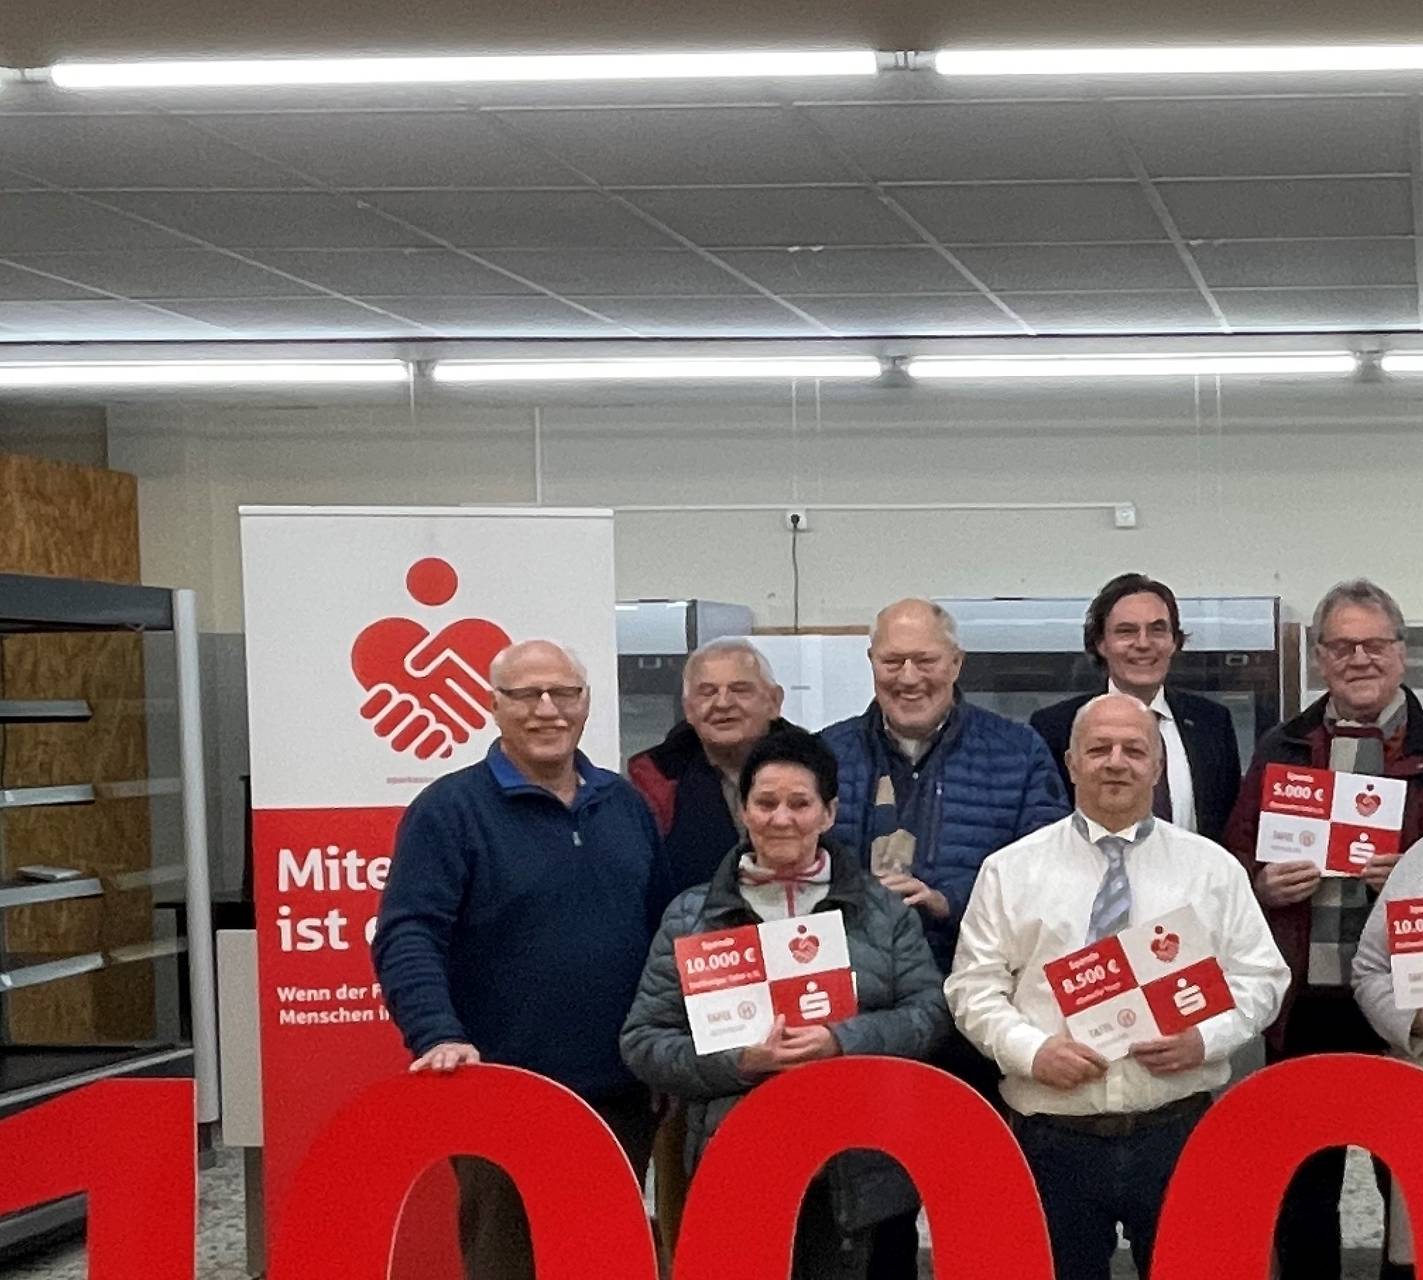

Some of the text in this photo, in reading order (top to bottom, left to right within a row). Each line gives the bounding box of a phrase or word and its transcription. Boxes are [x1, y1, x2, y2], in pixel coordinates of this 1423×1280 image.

[1273, 782, 1324, 801] 5.000 €
[276, 906, 350, 952] ist
[686, 947, 755, 974] 10.000 €
[1062, 965, 1106, 994] 8.500
[277, 986, 331, 1001] Wenn
[336, 984, 366, 999] der
[279, 1007, 374, 1024] Menschen
